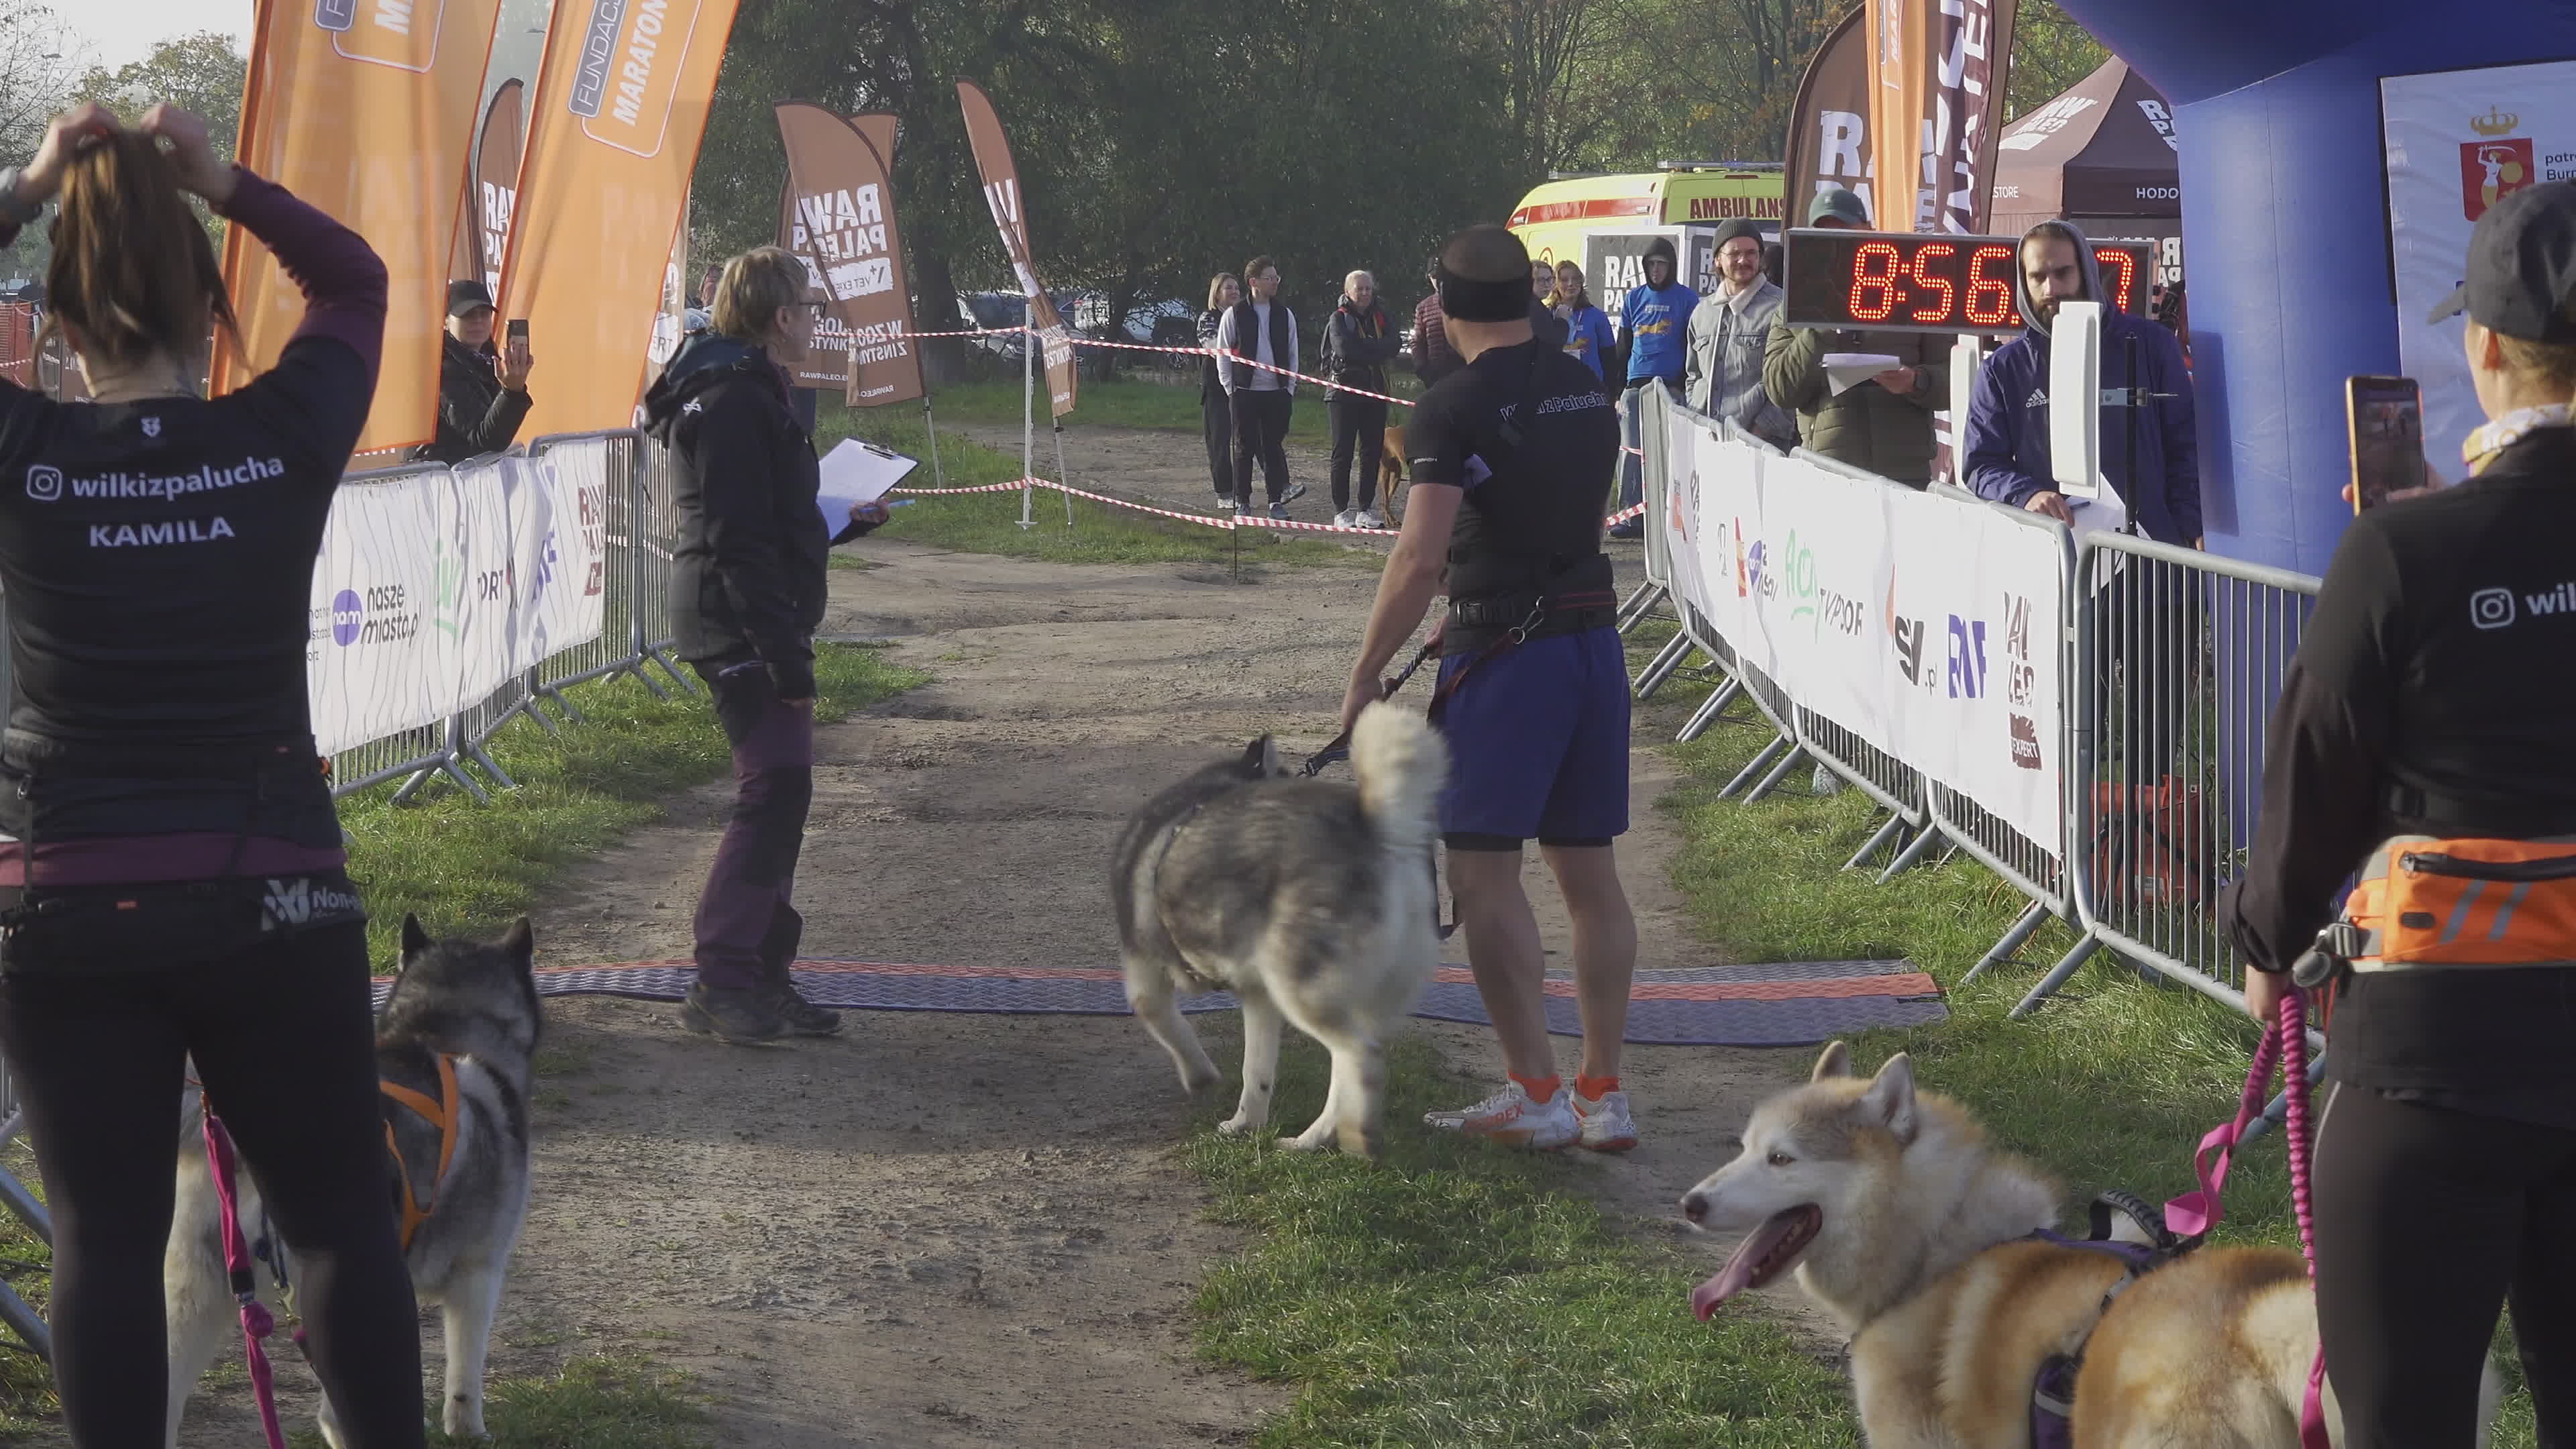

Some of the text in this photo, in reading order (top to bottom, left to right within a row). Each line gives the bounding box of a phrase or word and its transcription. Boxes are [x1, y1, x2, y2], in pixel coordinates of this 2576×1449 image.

[2545, 152, 2576, 166] patr
[72, 456, 284, 501] wilkizpalucha
[90, 516, 235, 547] KAMILA
[367, 584, 405, 612] nasze
